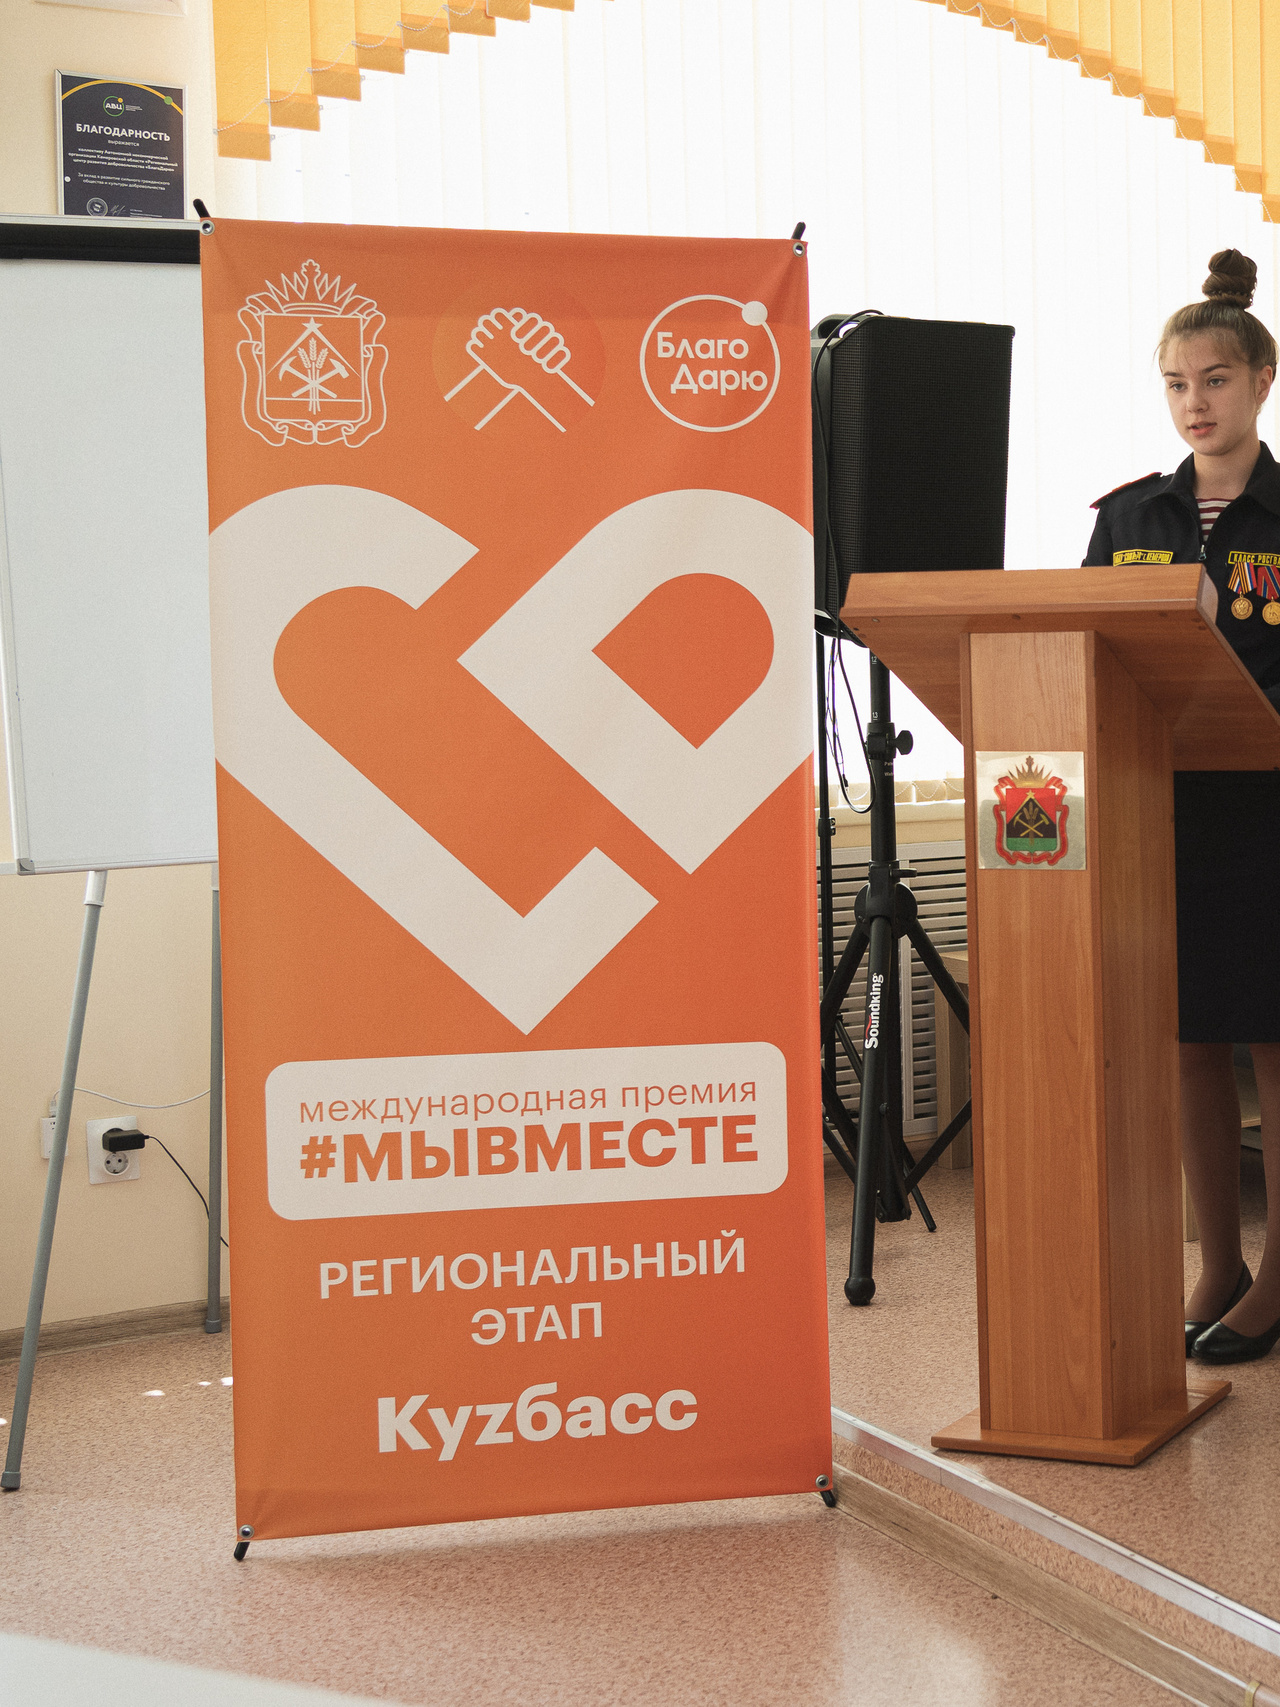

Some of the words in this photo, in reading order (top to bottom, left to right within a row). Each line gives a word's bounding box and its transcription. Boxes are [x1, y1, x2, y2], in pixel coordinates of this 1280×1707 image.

[76, 123, 170, 142] БЛАГОДАРНОСТЬ
[657, 332, 749, 360] Благо
[670, 364, 768, 396] Дарю
[1234, 553, 1256, 563] КЛАСС
[864, 972, 884, 1049] Soundking
[300, 1088, 607, 1126] международная
[621, 1082, 757, 1113] премия
[300, 1114, 758, 1184] #МЫВМЕСТЕ
[319, 1229, 746, 1300] РЕГИОНАЛЬНЫЙ
[470, 1301, 603, 1346] ЭТАП
